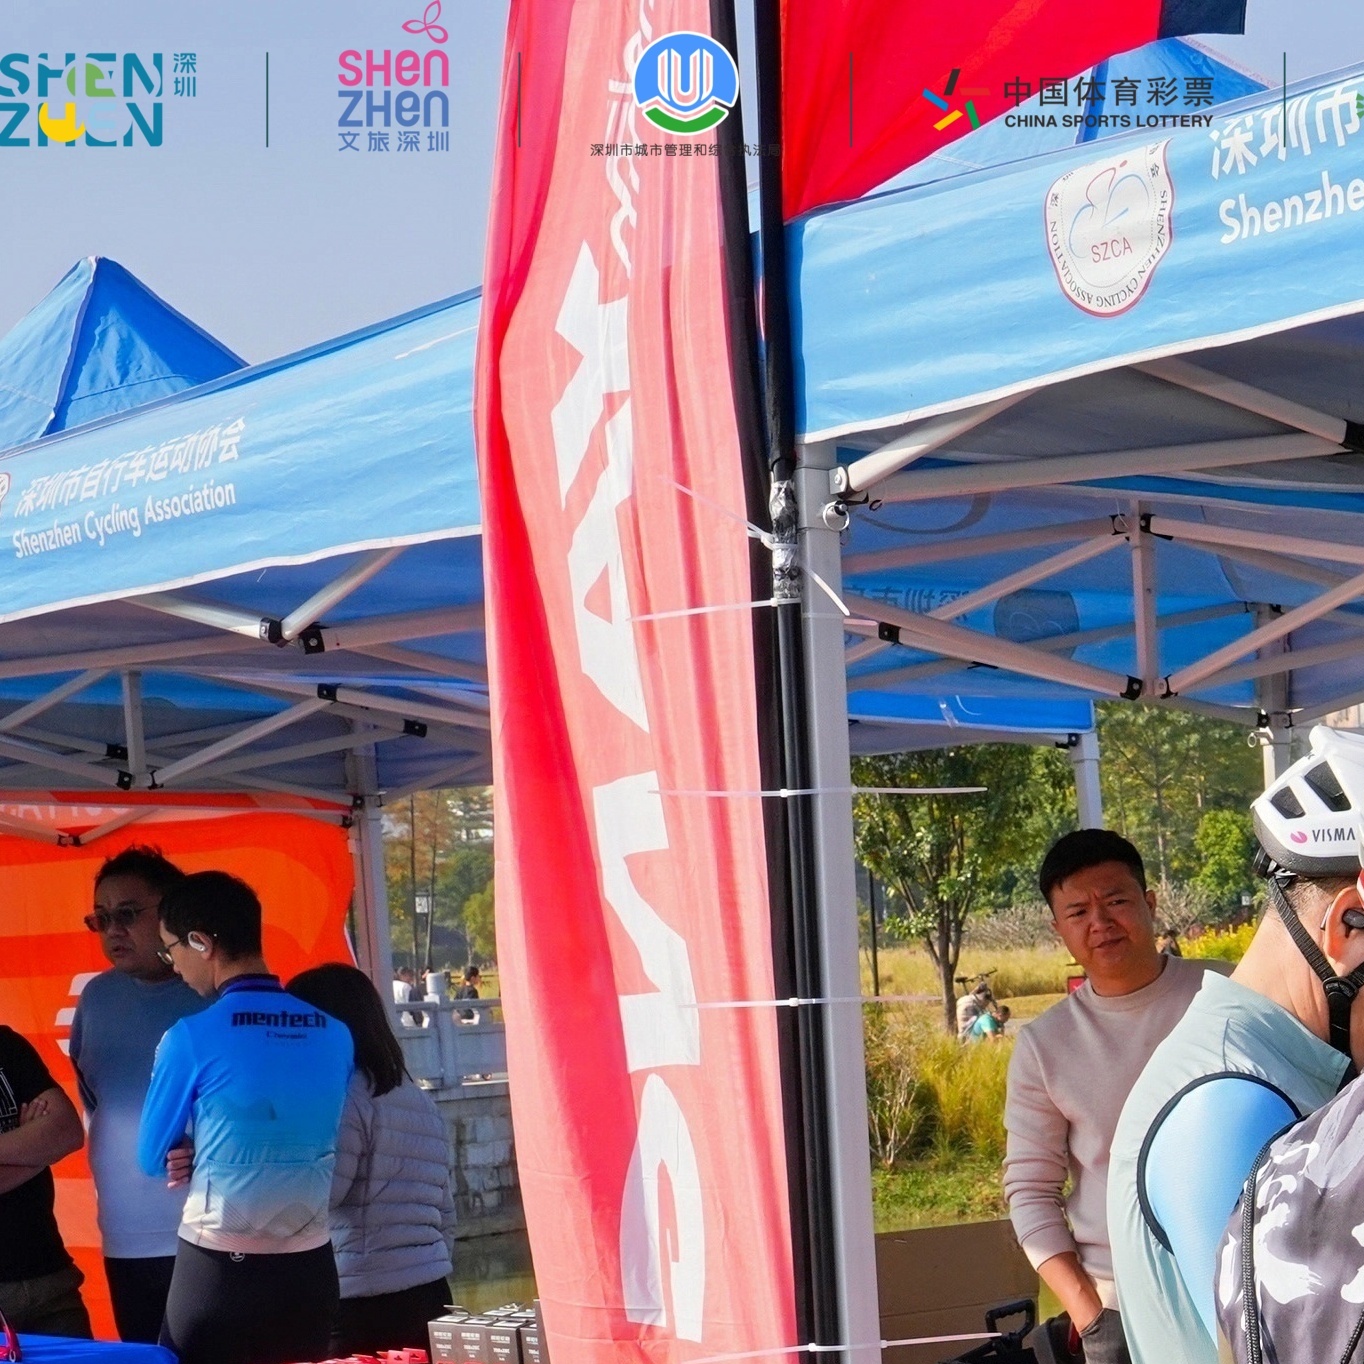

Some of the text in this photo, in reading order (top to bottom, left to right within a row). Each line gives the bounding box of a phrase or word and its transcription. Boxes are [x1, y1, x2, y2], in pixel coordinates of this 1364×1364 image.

[1091, 236, 1133, 263] SZCA
[15, 417, 246, 518] 深圳市自行车运动协会
[12, 479, 236, 558] Shenzhen Cycling Association
[1312, 828, 1356, 843] VISMA
